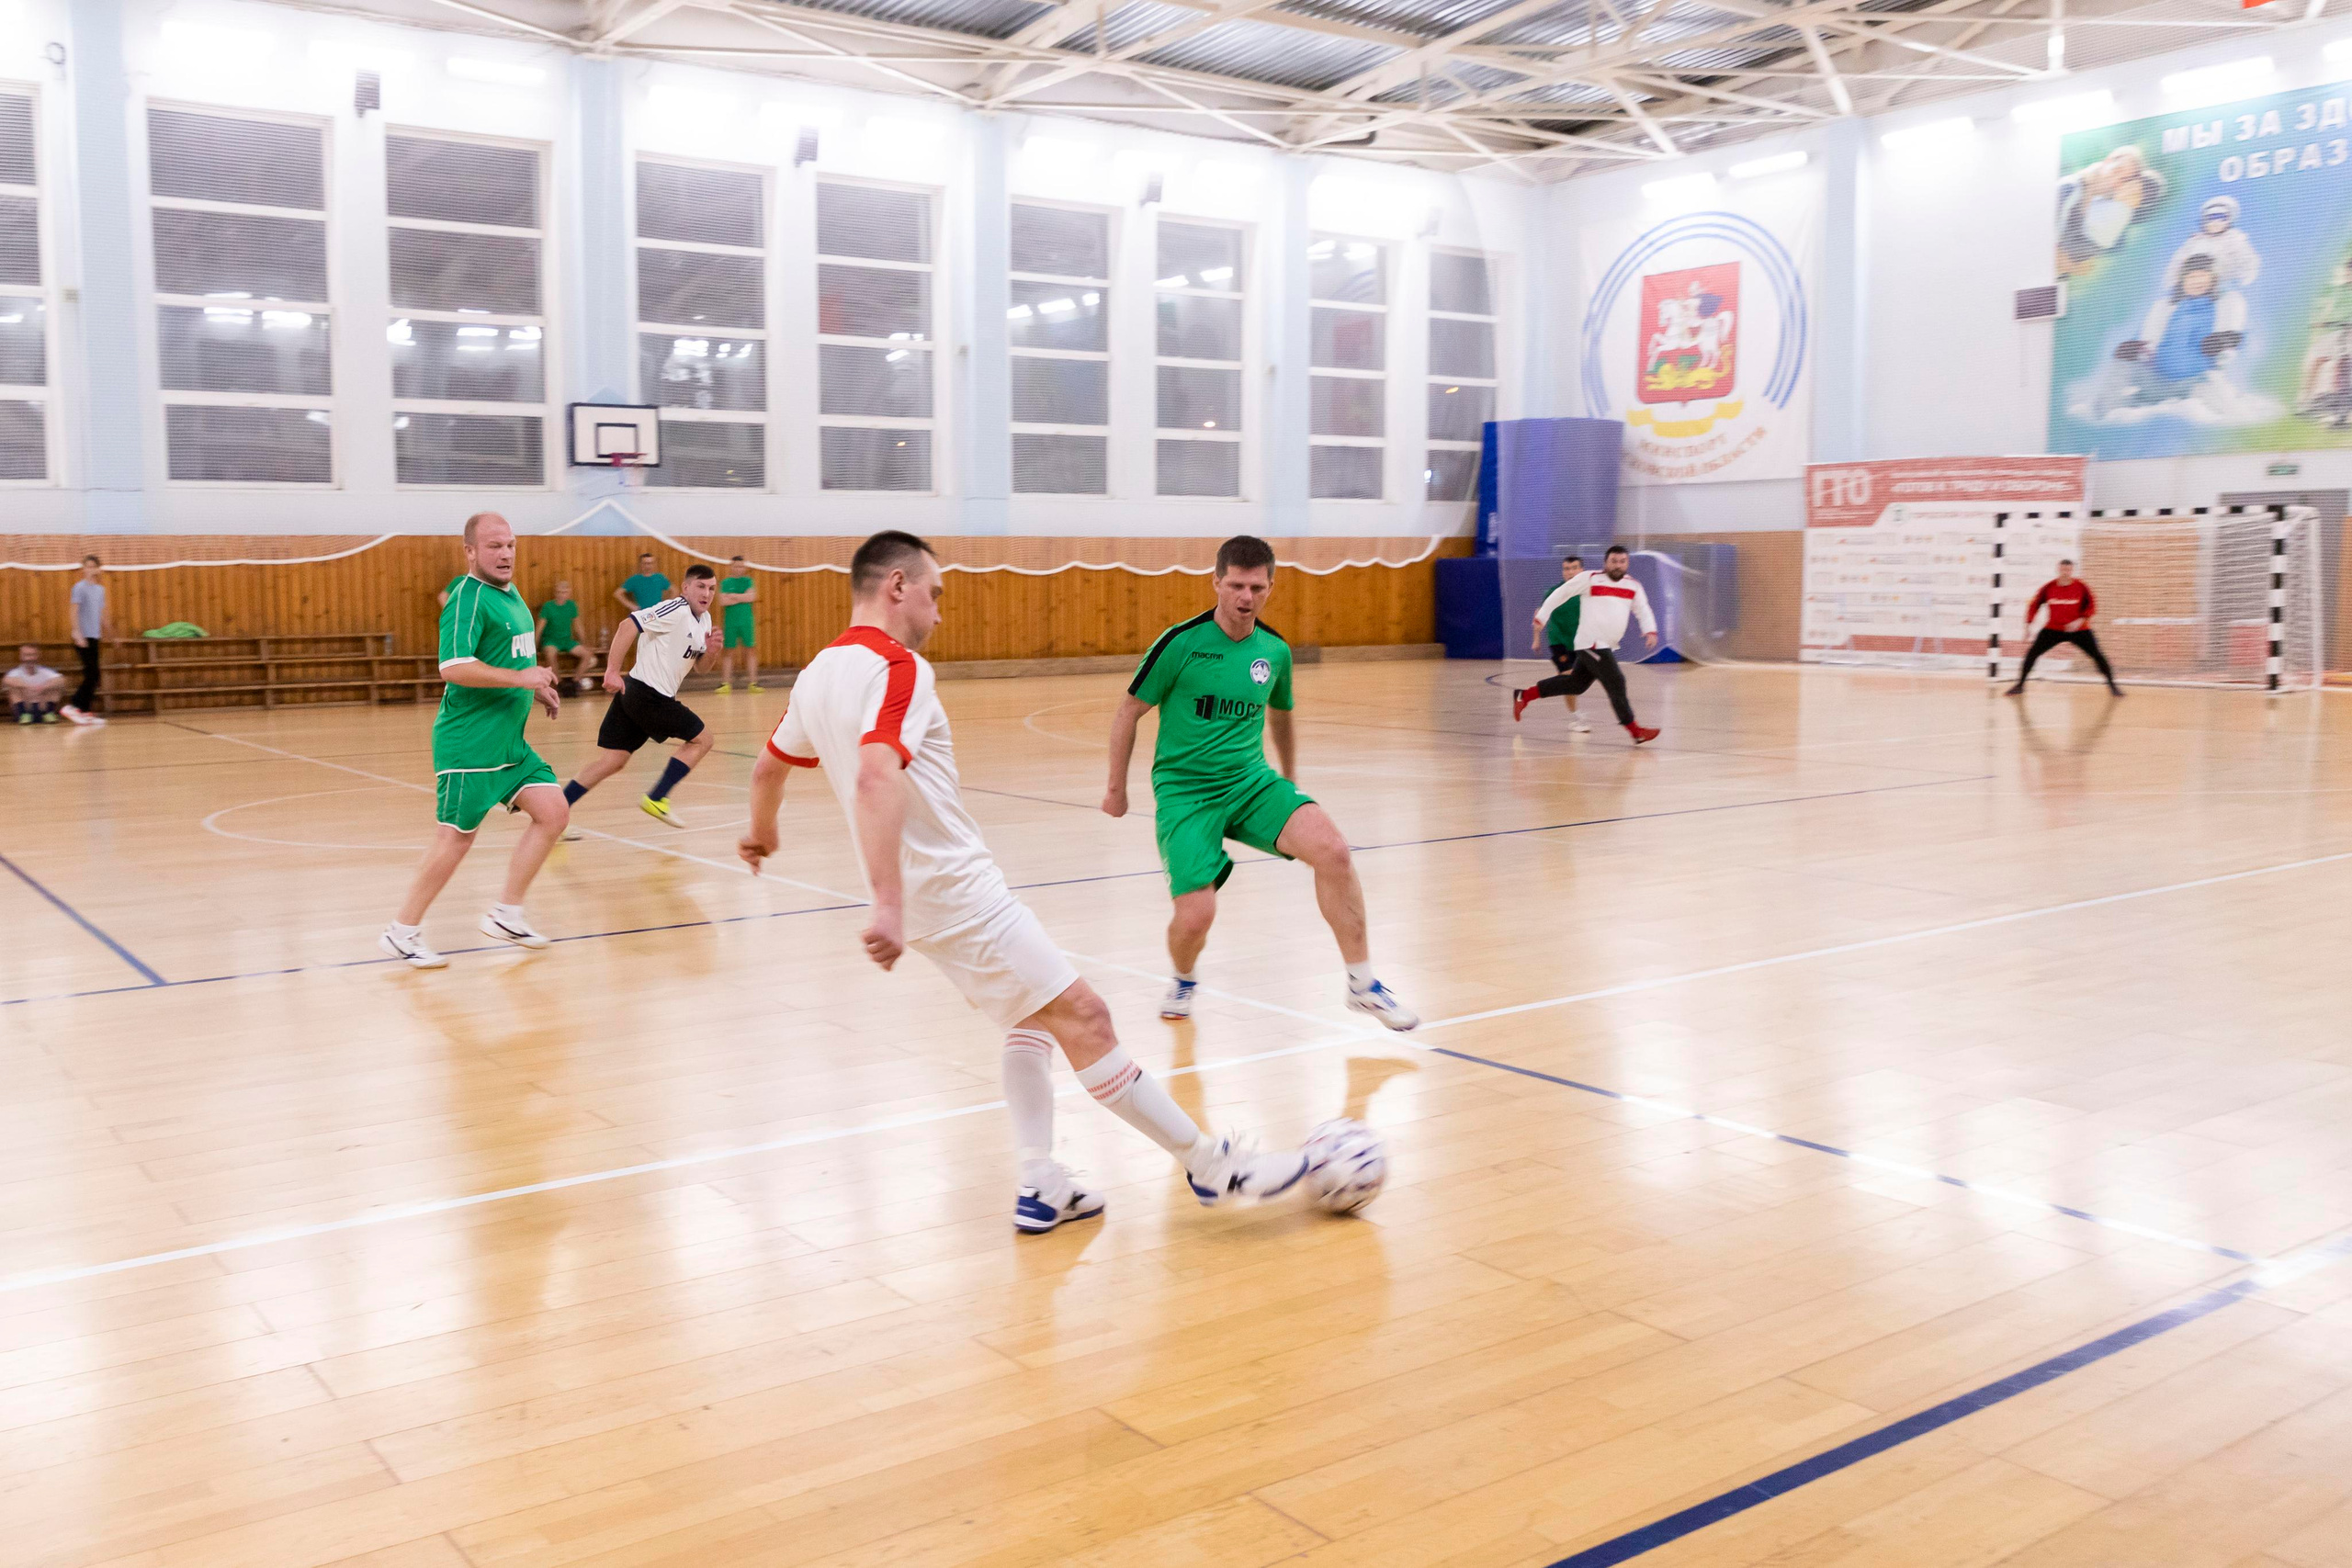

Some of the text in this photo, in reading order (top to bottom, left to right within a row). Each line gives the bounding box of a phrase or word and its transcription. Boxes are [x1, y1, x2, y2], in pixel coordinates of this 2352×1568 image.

[2162, 96, 2352, 154] МЫ ЗА ЗД
[2219, 138, 2348, 183] ОБРАЗ
